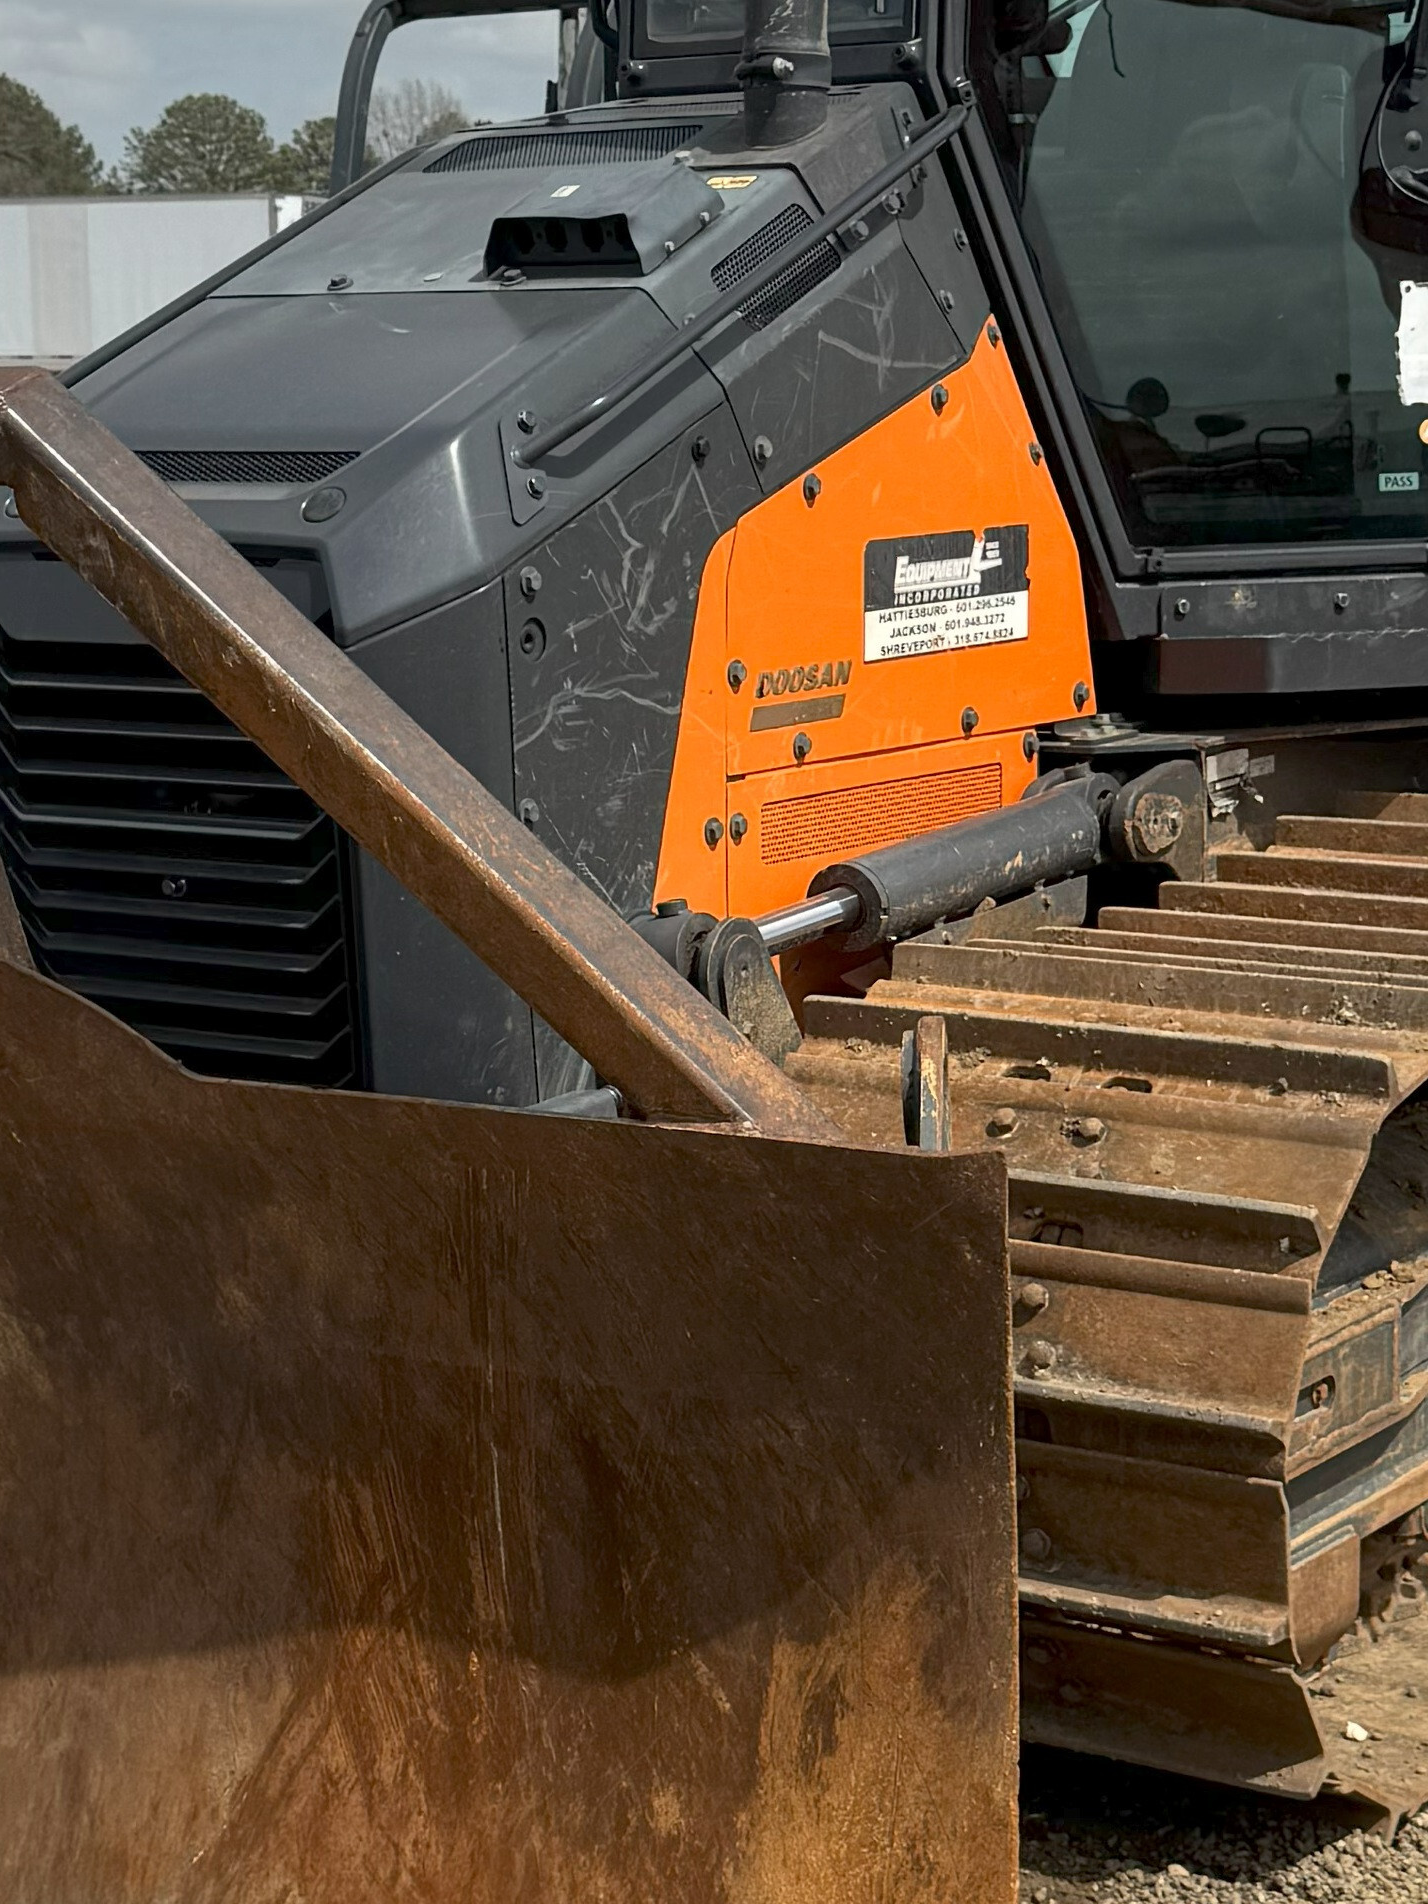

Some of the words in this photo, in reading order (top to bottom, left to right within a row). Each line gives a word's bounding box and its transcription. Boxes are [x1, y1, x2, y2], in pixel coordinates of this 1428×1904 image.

[1384, 476, 1413, 488] PASS
[894, 584, 980, 605] INCORPORATED
[879, 604, 948, 623] HATTIESBURG
[890, 622, 936, 639] JACKSON
[880, 637, 945, 657] SHREVEPORT
[755, 659, 852, 699] DOOSAN
